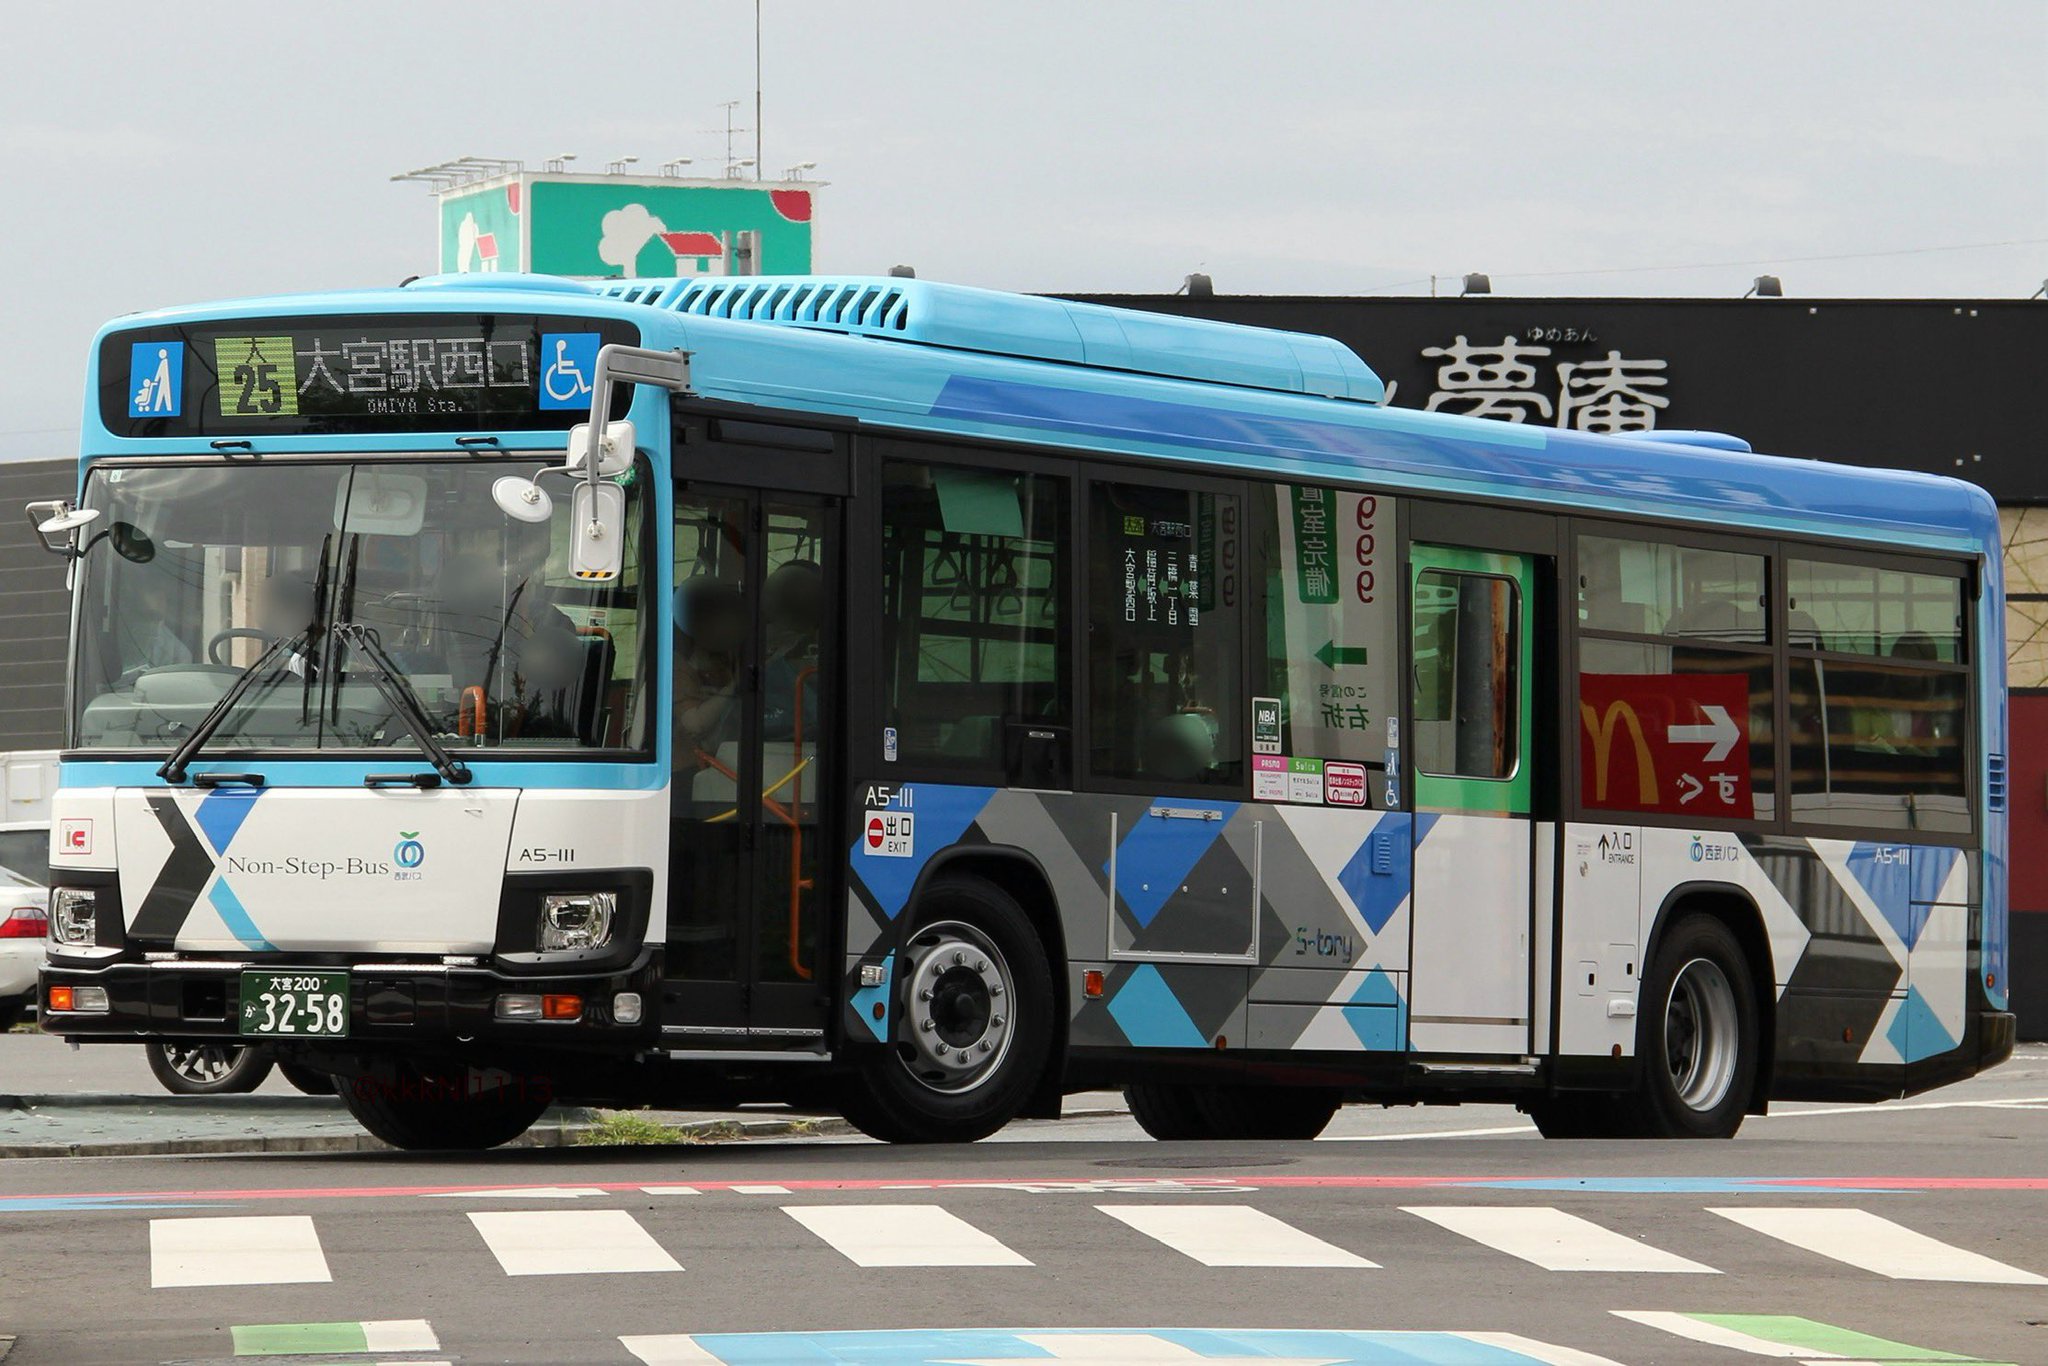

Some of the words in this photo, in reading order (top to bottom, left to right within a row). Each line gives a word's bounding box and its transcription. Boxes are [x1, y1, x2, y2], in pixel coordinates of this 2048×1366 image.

[1527, 326, 1598, 343] ゆめあん
[296, 336, 530, 394] 大宮駅西口
[234, 364, 282, 414] 25
[427, 397, 463, 413] Sta.
[1258, 710, 1276, 724] NBA
[1295, 761, 1316, 772] Suica
[886, 816, 912, 837] 出口
[888, 841, 907, 853] EXIT
[1611, 832, 1632, 850] 入口
[1608, 853, 1635, 865] ENTRANCE
[1705, 845, 1739, 862] 西武バス
[228, 857, 389, 879] Non-Step-Bus
[245, 1005, 257, 1019] か
[258, 992, 344, 1034] 32-58
